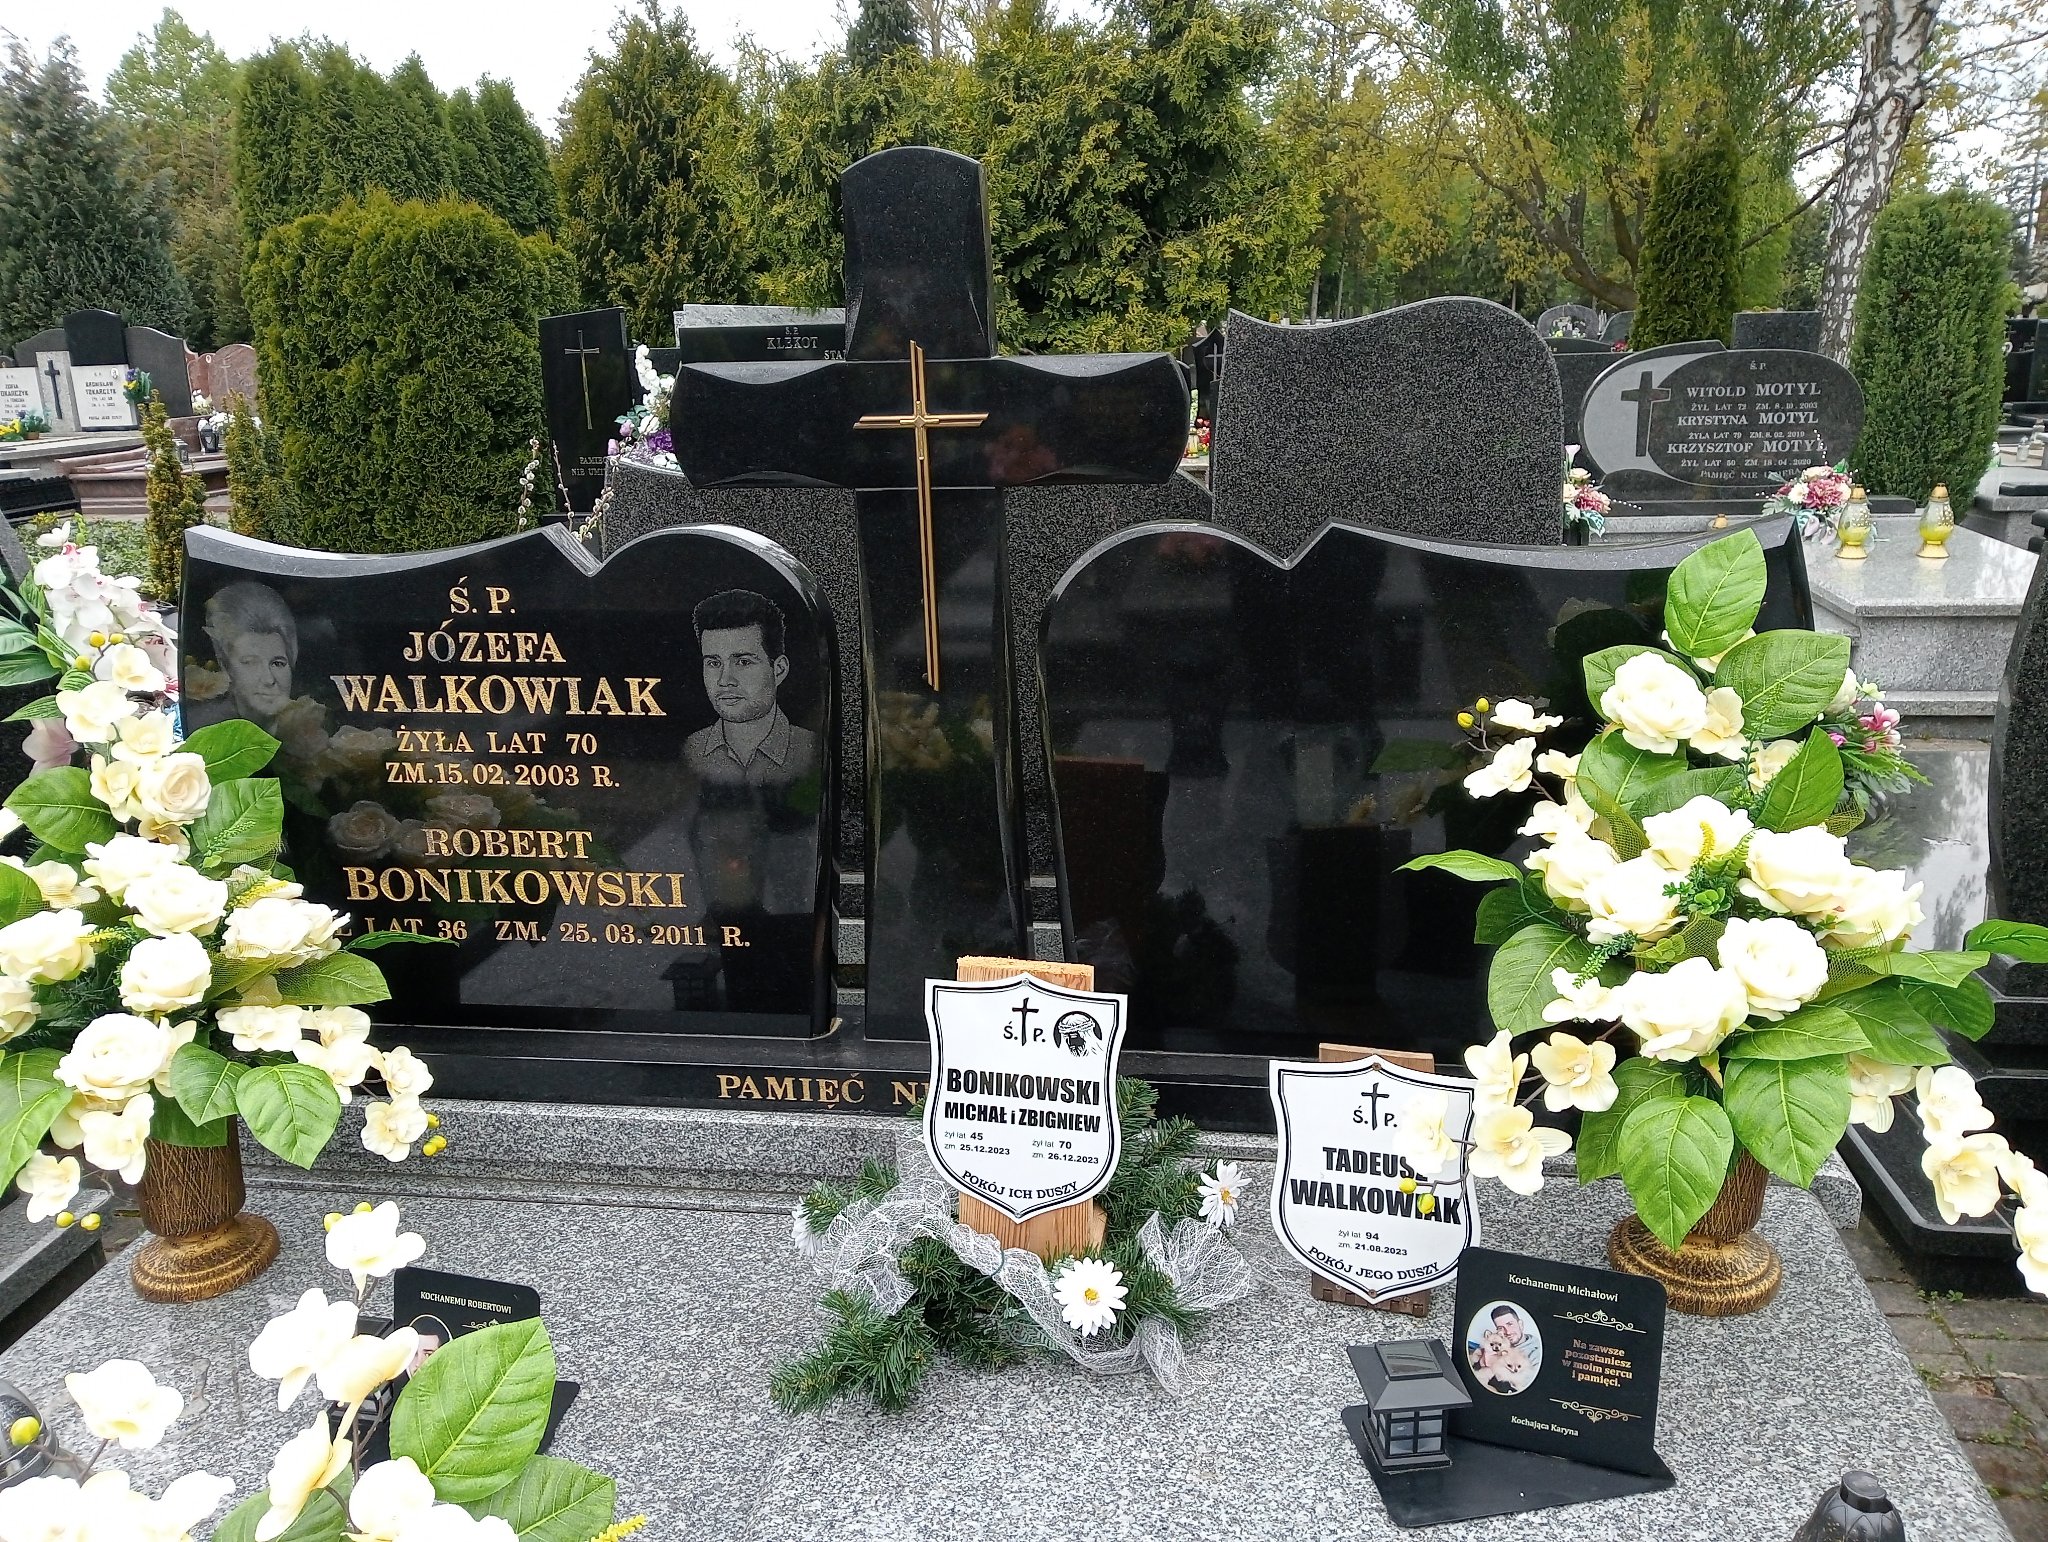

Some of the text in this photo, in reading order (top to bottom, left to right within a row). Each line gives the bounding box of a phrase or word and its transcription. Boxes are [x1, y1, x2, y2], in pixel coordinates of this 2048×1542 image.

[766, 336, 819, 350] KLEKOT
[1686, 382, 1821, 398] WITOLD MOTYL
[1715, 403, 1733, 411] LAT
[1677, 411, 1819, 426] KRYSTYNA MOTYL
[1713, 431, 1730, 439] LAT
[1667, 439, 1828, 454] KRZYSZTOF MOTYL
[1704, 459, 1722, 467] LAT
[1740, 471, 1758, 479] NIE
[402, 618, 567, 664] JÓZEFA
[329, 674, 667, 717] WALKOWIAK
[396, 724, 599, 756] ŻYŁA LAT 70
[591, 765, 621, 788] R.
[423, 827, 593, 860] ROBERT
[342, 866, 688, 908] BONIKOWSKI
[437, 919, 469, 940] 36
[494, 919, 548, 942] ZM.
[720, 925, 751, 948] R.
[716, 1071, 931, 1110] PAMIĘĆ NI
[946, 1067, 1101, 1106] BONIKOWSKI
[944, 1101, 1101, 1134] MICHAŁ i ZBIGNIEW
[970, 1132, 984, 1141] 45
[1058, 1140, 1072, 1150] 70
[959, 1143, 1011, 1156] 25.12.2023
[1047, 1152, 1100, 1165] 26.12.2023
[1322, 1146, 1428, 1182] TADEUS
[962, 1170, 1079, 1200] POKÓJ ICH DUSZY
[1365, 1231, 1380, 1241] 94
[1354, 1242, 1408, 1257] 21.08.2023
[1309, 1245, 1440, 1281] POKÓJ JEGO DUSZY
[1508, 1273, 1619, 1303] Kochanemu Michałowi
[420, 1290, 512, 1315] KOCHANEMU ROBERTOWI
[1572, 1338, 1625, 1357] Na zawsze
[1564, 1349, 1632, 1369] pozostaniesz
[1561, 1359, 1633, 1380] w moim sercu
[1577, 1372, 1621, 1388] pamięci.
[1510, 1415, 1579, 1437] Kochająca Karyna
